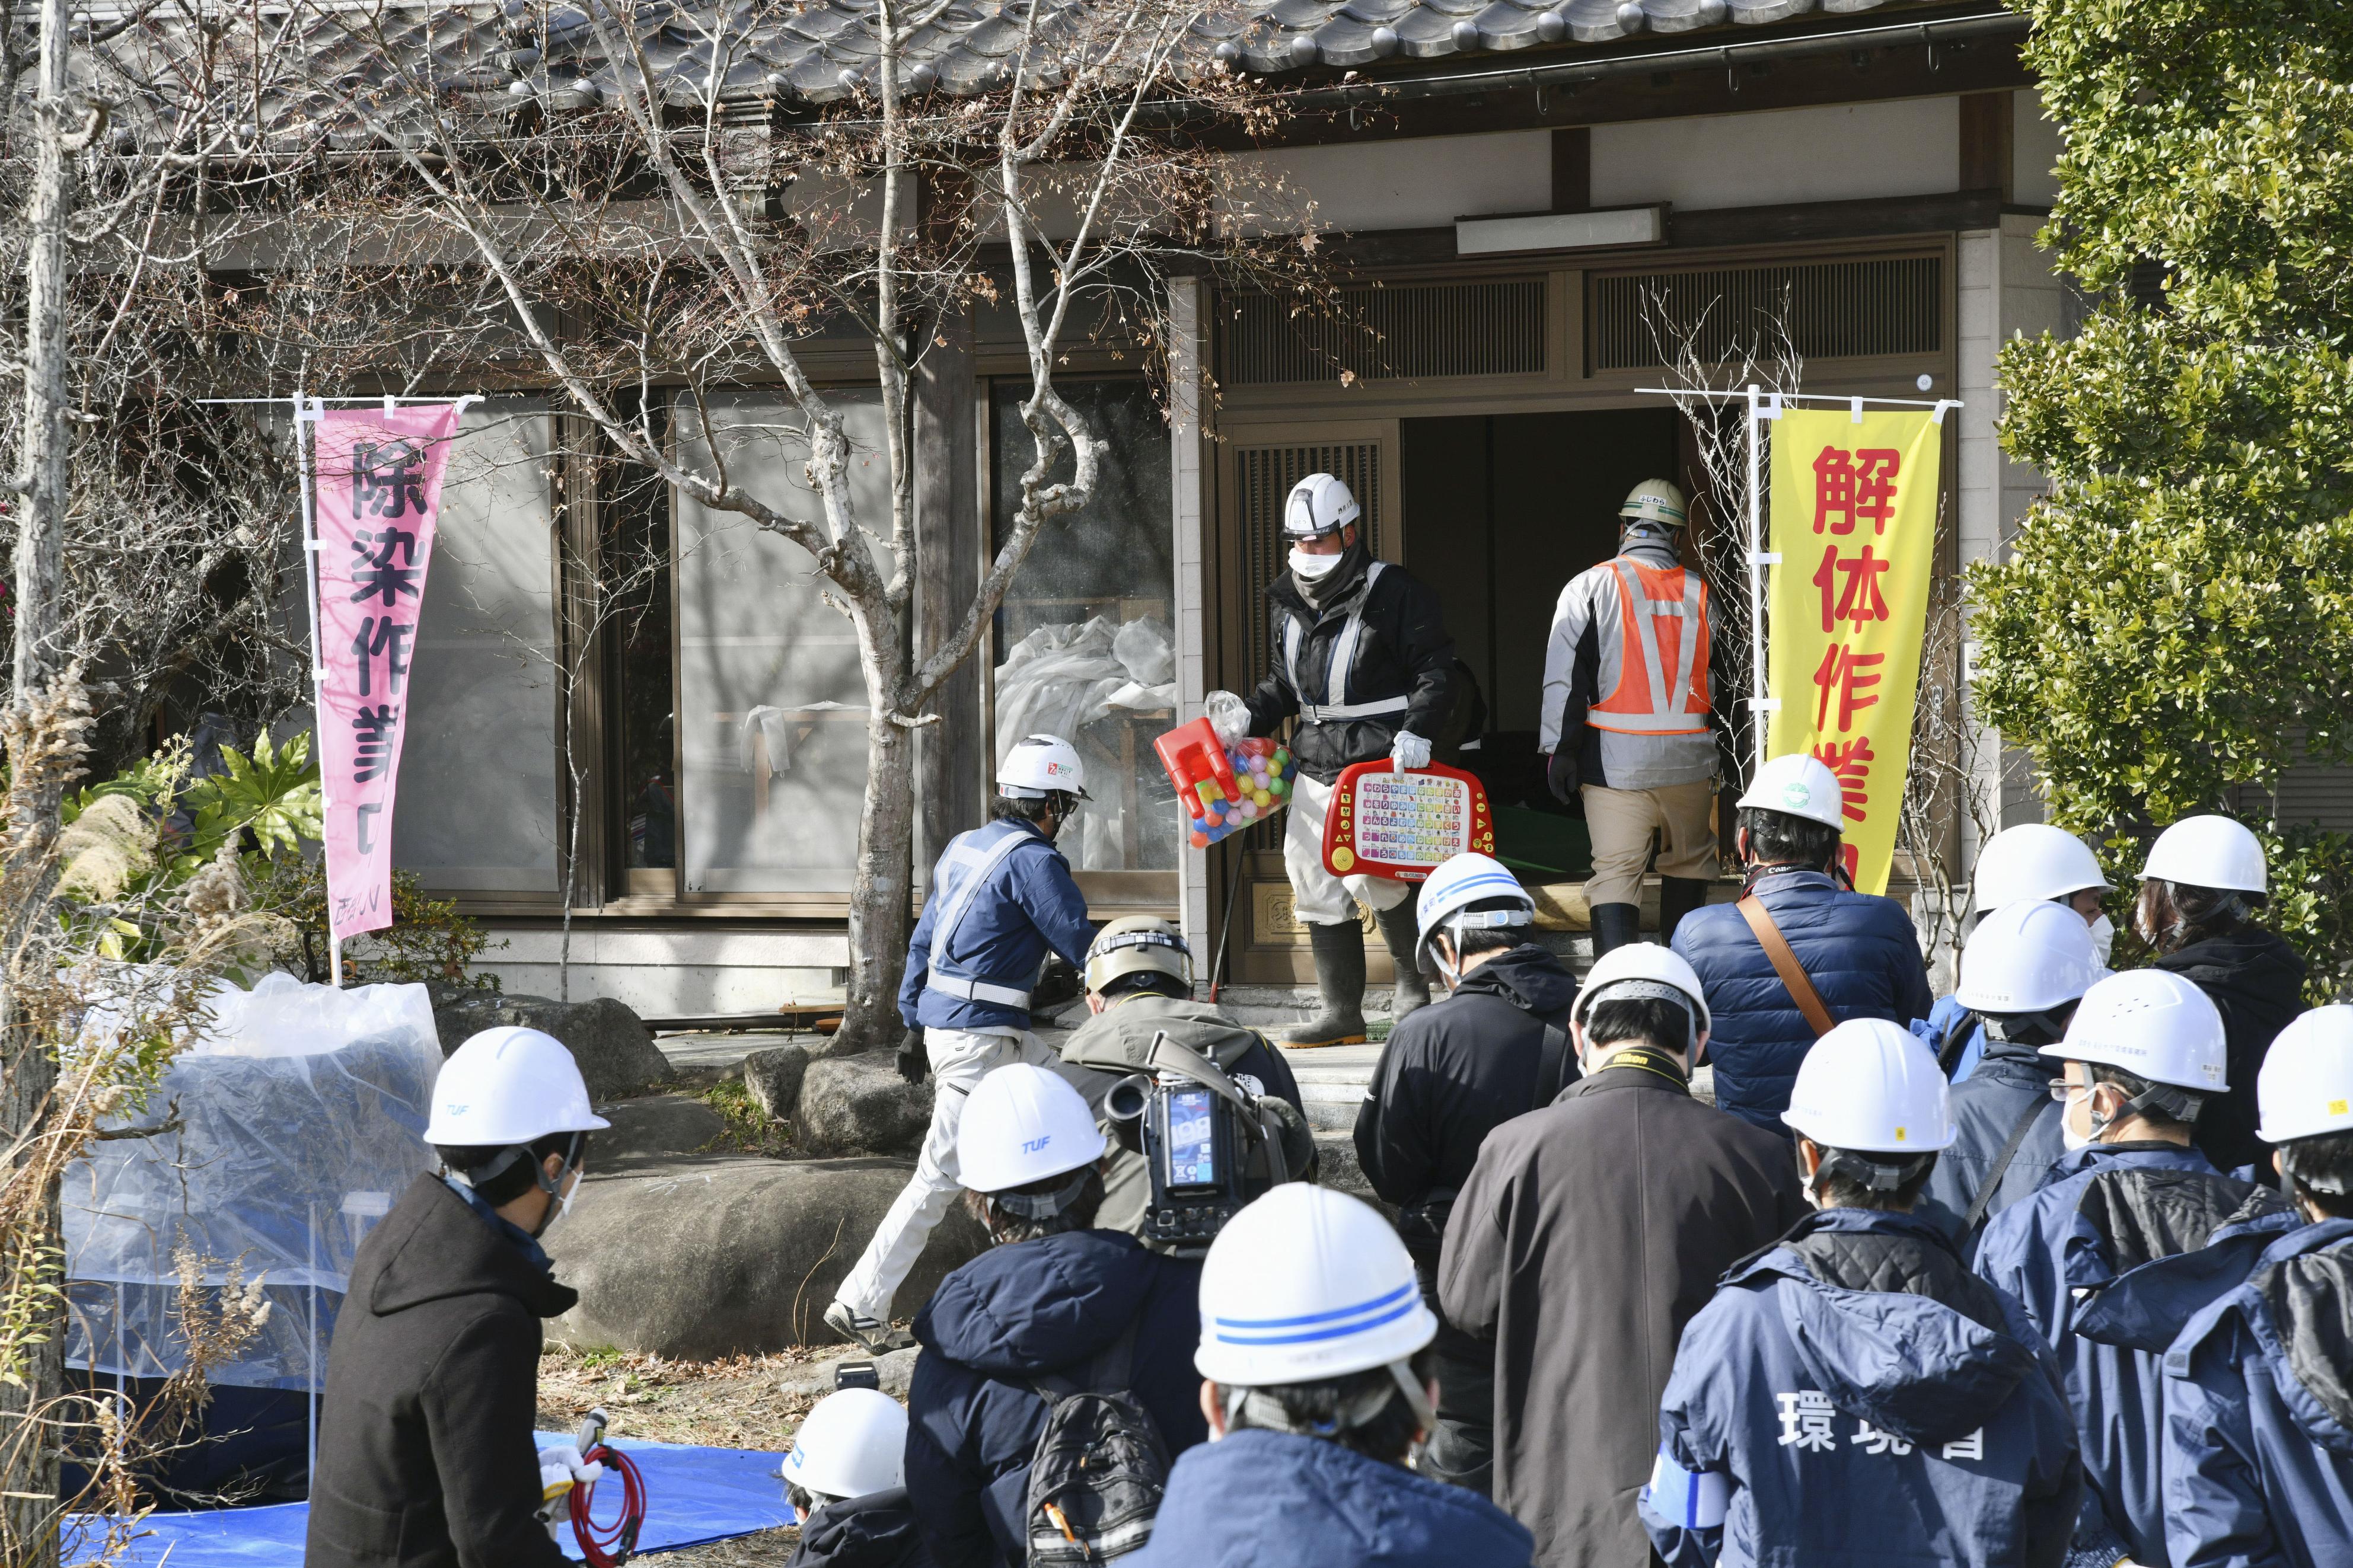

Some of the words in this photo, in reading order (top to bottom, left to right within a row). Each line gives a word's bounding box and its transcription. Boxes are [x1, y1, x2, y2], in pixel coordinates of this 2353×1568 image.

[1640, 496, 1665, 505] ふじわら
[1813, 445, 1900, 890] 解体作業
[1612, 1053, 1648, 1065] Nikon
[447, 1104, 469, 1116] TUF
[1022, 1136, 1050, 1154] TUF
